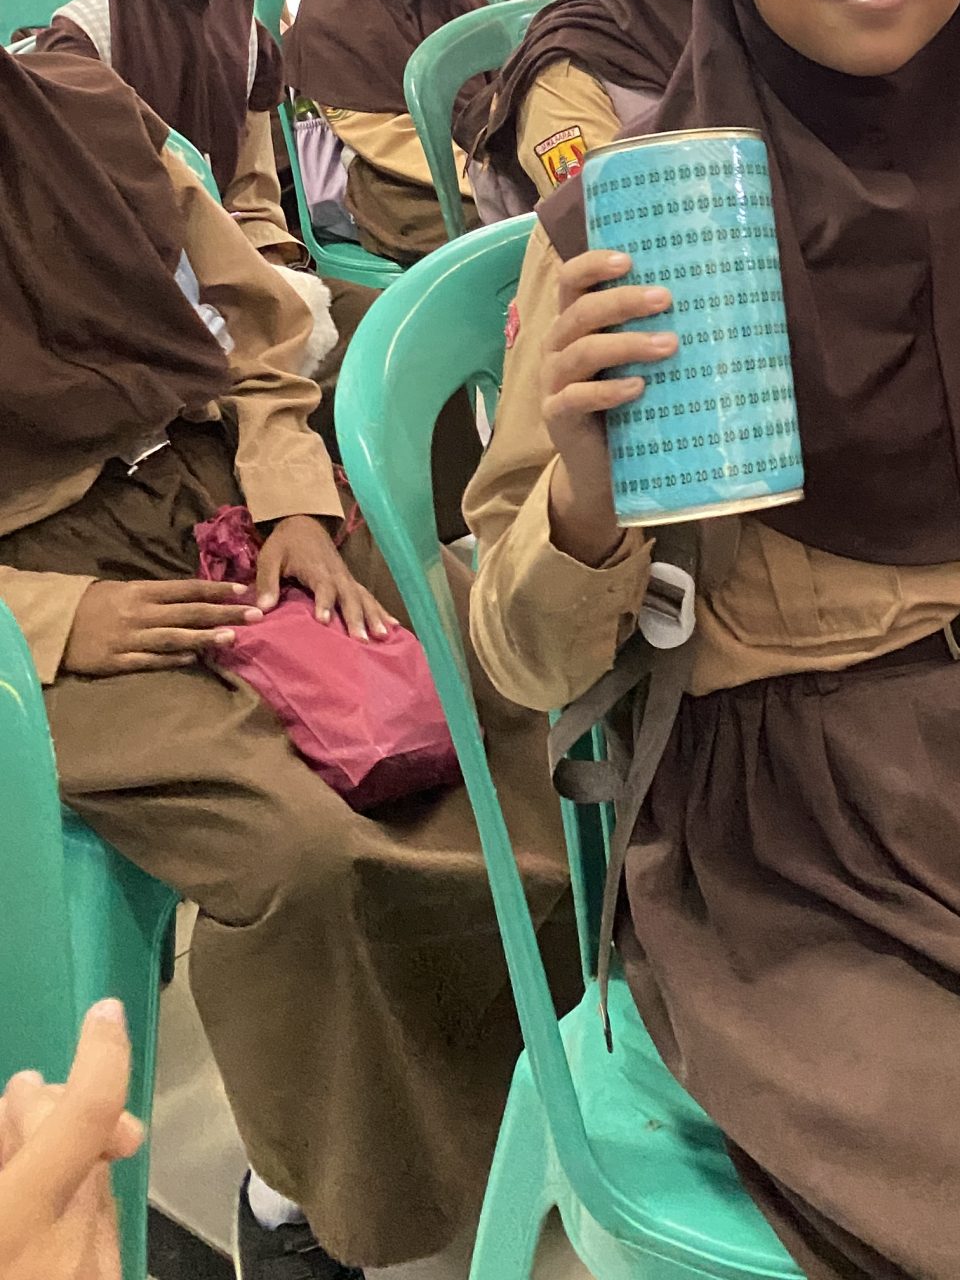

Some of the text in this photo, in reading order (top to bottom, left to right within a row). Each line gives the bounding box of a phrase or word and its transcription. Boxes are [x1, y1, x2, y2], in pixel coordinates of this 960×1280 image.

[664, 169, 675, 181] 20
[694, 165, 706, 177] 20
[709, 164, 720, 176] 20
[652, 203, 663, 216] 20
[667, 201, 679, 214] 20
[682, 199, 694, 212] 20
[697, 197, 709, 210] 20
[641, 239, 652, 251] 20
[655, 236, 667, 249] 20
[670, 234, 682, 246] 20
[686, 231, 698, 244] 20
[701, 229, 713, 242] 20
[716, 228, 728, 241] 20
[659, 269, 671, 281] 20
[674, 266, 686, 279] 20
[690, 264, 701, 277] 20
[705, 262, 717, 275] 20
[677, 300, 690, 312] 20
[694, 298, 705, 310] 20
[708, 296, 720, 308] 20
[723, 294, 735, 306] 20
[738, 292, 748, 304] 20
[681, 333, 693, 346] 20
[697, 331, 709, 343] 20
[712, 329, 724, 341] 20
[727, 327, 739, 339] 20
[741, 326, 752, 337] 20
[669, 369, 681, 382] 20
[685, 367, 697, 380] 20
[700, 365, 713, 377] 20
[730, 361, 741, 373] 20
[744, 359, 755, 371] 20
[658, 406, 670, 418] 20
[672, 404, 685, 416] 20
[688, 401, 701, 413] 20
[703, 399, 716, 411] 20
[720, 397, 732, 409] 20
[735, 394, 746, 407] 20
[748, 392, 759, 405] 20
[661, 440, 673, 452] 20
[676, 438, 688, 450] 20
[692, 435, 704, 448] 20
[708, 433, 720, 445] 20
[723, 430, 735, 443] 20
[739, 428, 750, 440] 20
[753, 426, 763, 438] 20
[665, 474, 676, 487] 20
[680, 472, 692, 485] 20
[695, 470, 708, 483] 20
[712, 467, 724, 480] 20
[727, 465, 739, 478] 20
[742, 462, 754, 475] 20
[756, 460, 767, 473] 20
